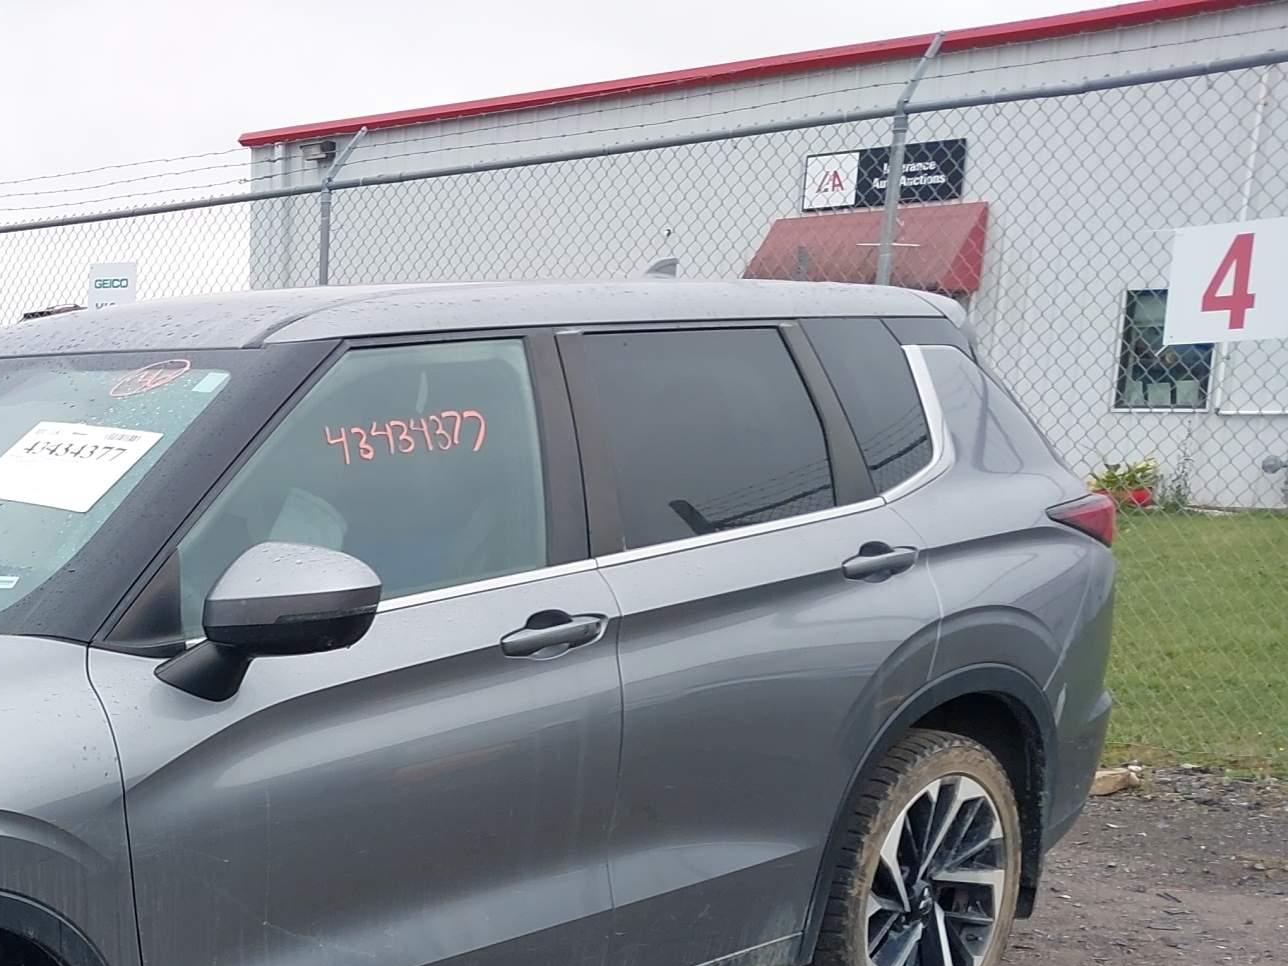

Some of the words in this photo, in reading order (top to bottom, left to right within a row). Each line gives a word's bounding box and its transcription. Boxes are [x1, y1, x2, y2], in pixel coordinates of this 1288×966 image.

[94, 278, 129, 289] GEICO
[1201, 232, 1255, 330] 4
[24, 440, 128, 462] 43434377
[325, 410, 486, 465] 43434377
